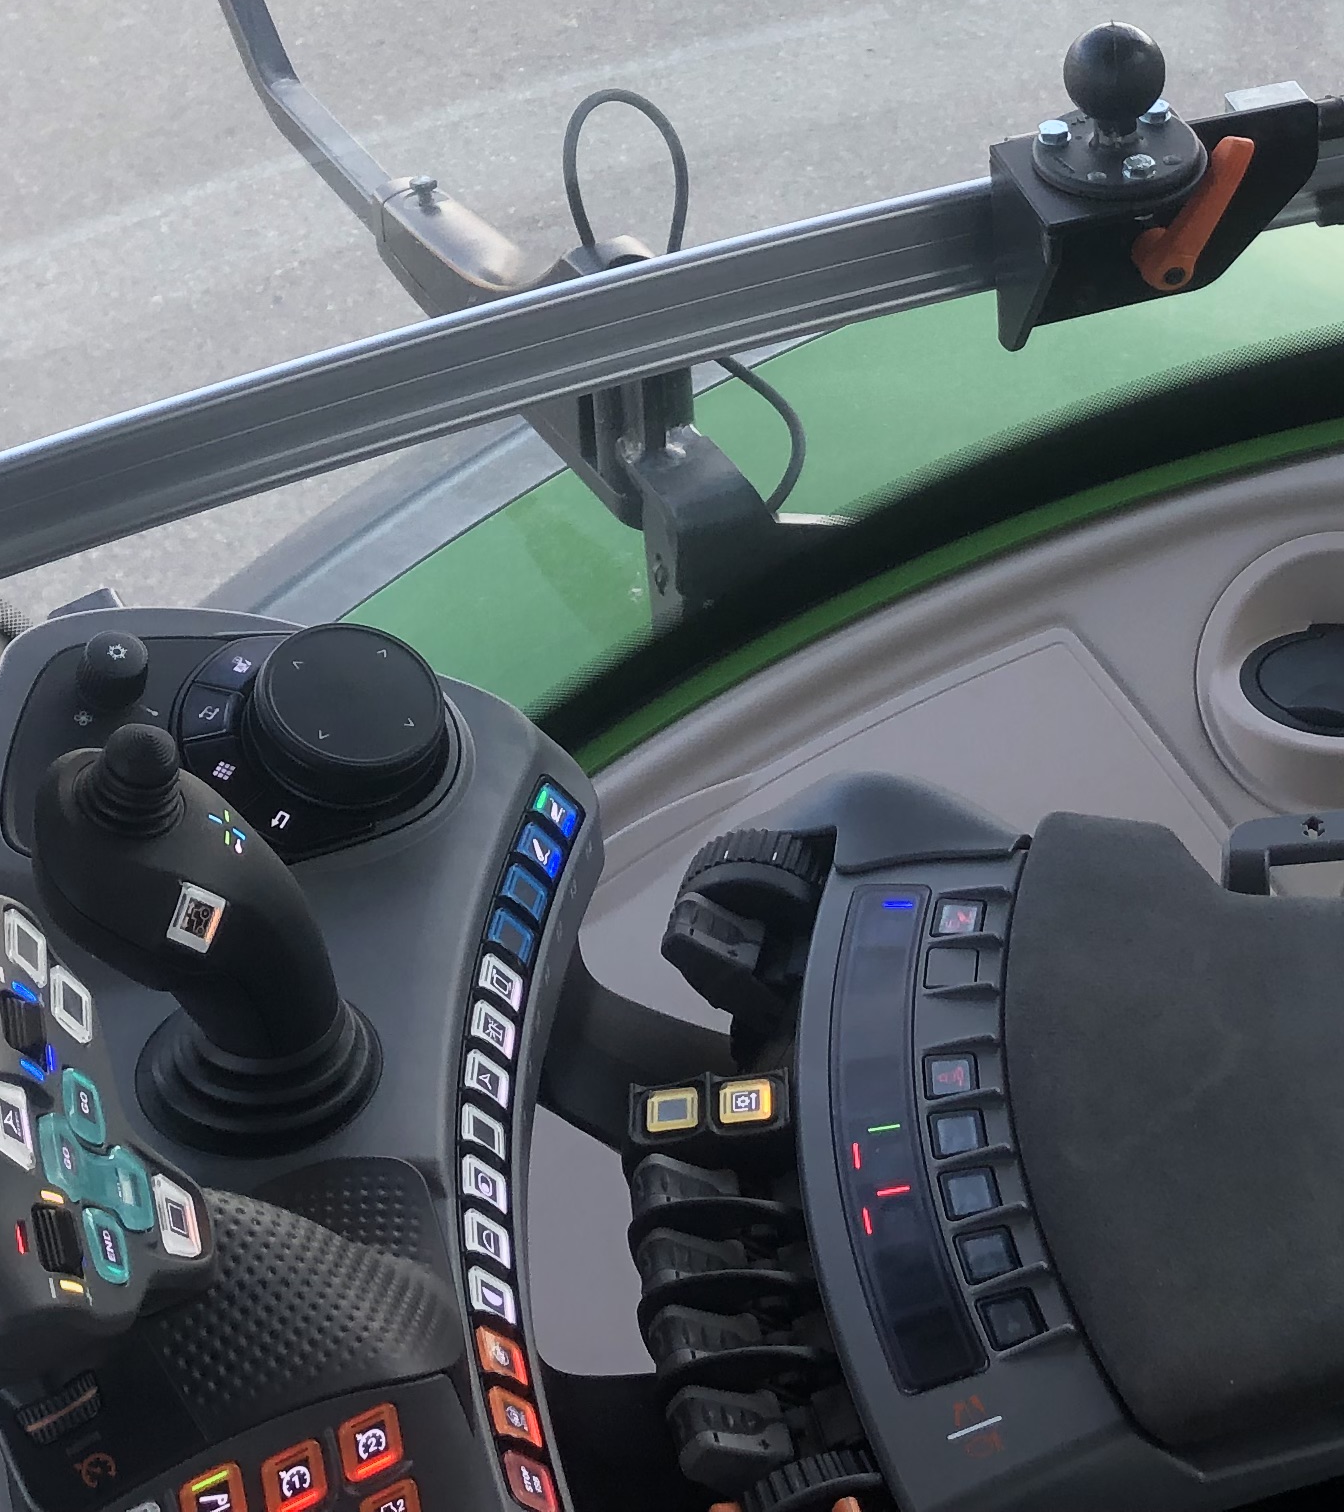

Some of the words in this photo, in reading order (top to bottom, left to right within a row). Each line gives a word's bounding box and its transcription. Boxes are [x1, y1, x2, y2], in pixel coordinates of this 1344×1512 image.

[79, 1091, 90, 1114] GO
[62, 1146, 72, 1170] GO
[102, 1230, 117, 1263] END
[520, 1465, 533, 1493] STOP
